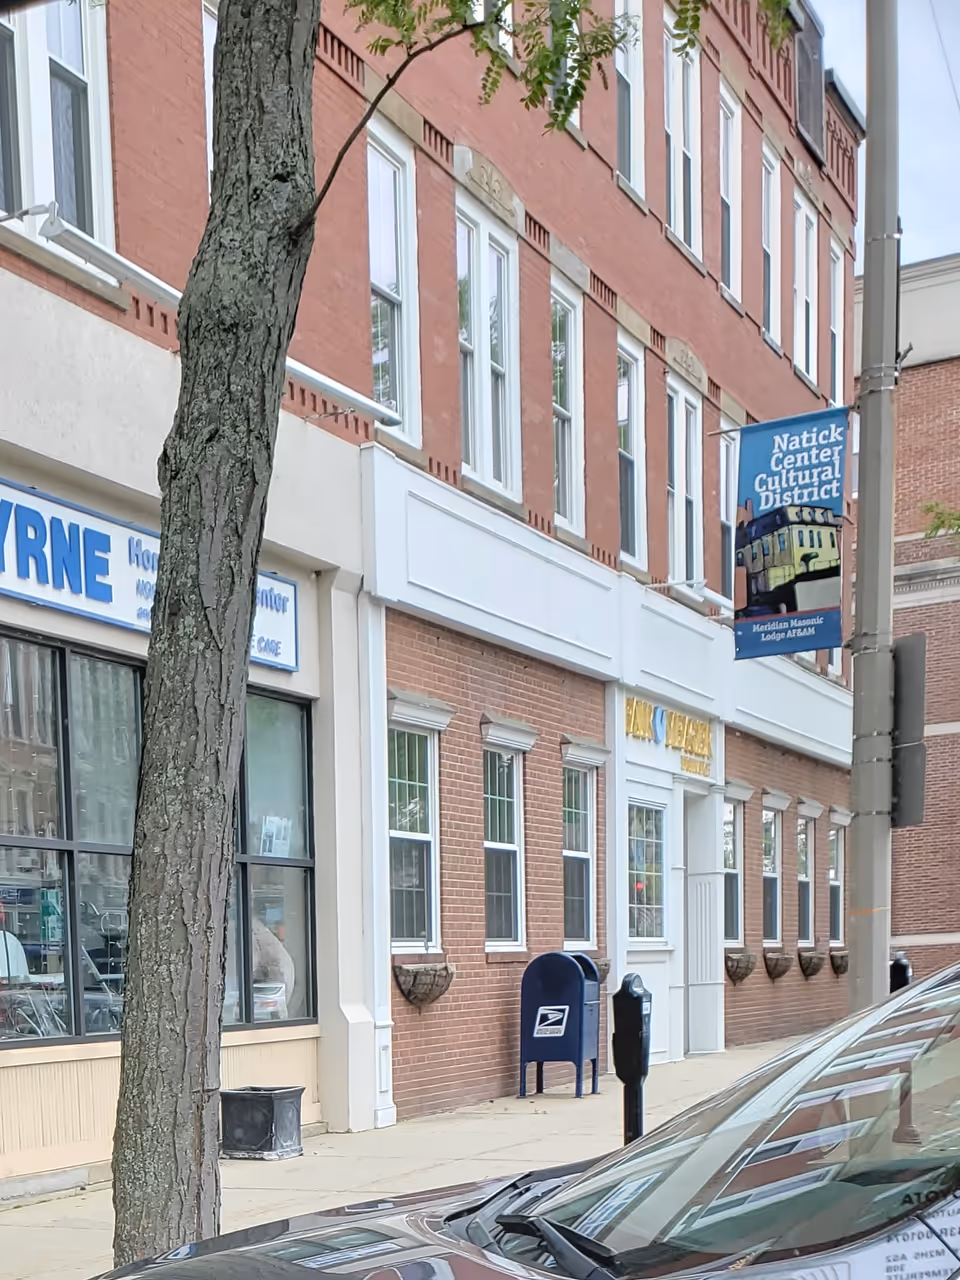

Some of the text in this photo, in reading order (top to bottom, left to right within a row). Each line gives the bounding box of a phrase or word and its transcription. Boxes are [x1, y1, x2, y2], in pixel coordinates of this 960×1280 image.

[772, 423, 844, 453] Natick
[770, 446, 843, 472] Center
[754, 459, 841, 493] Cultural
[759, 481, 840, 511] District
[128, 536, 158, 573] Ho
[752, 615, 824, 633] Meridian Masonic
[760, 626, 816, 642] Lodge AF&AM
